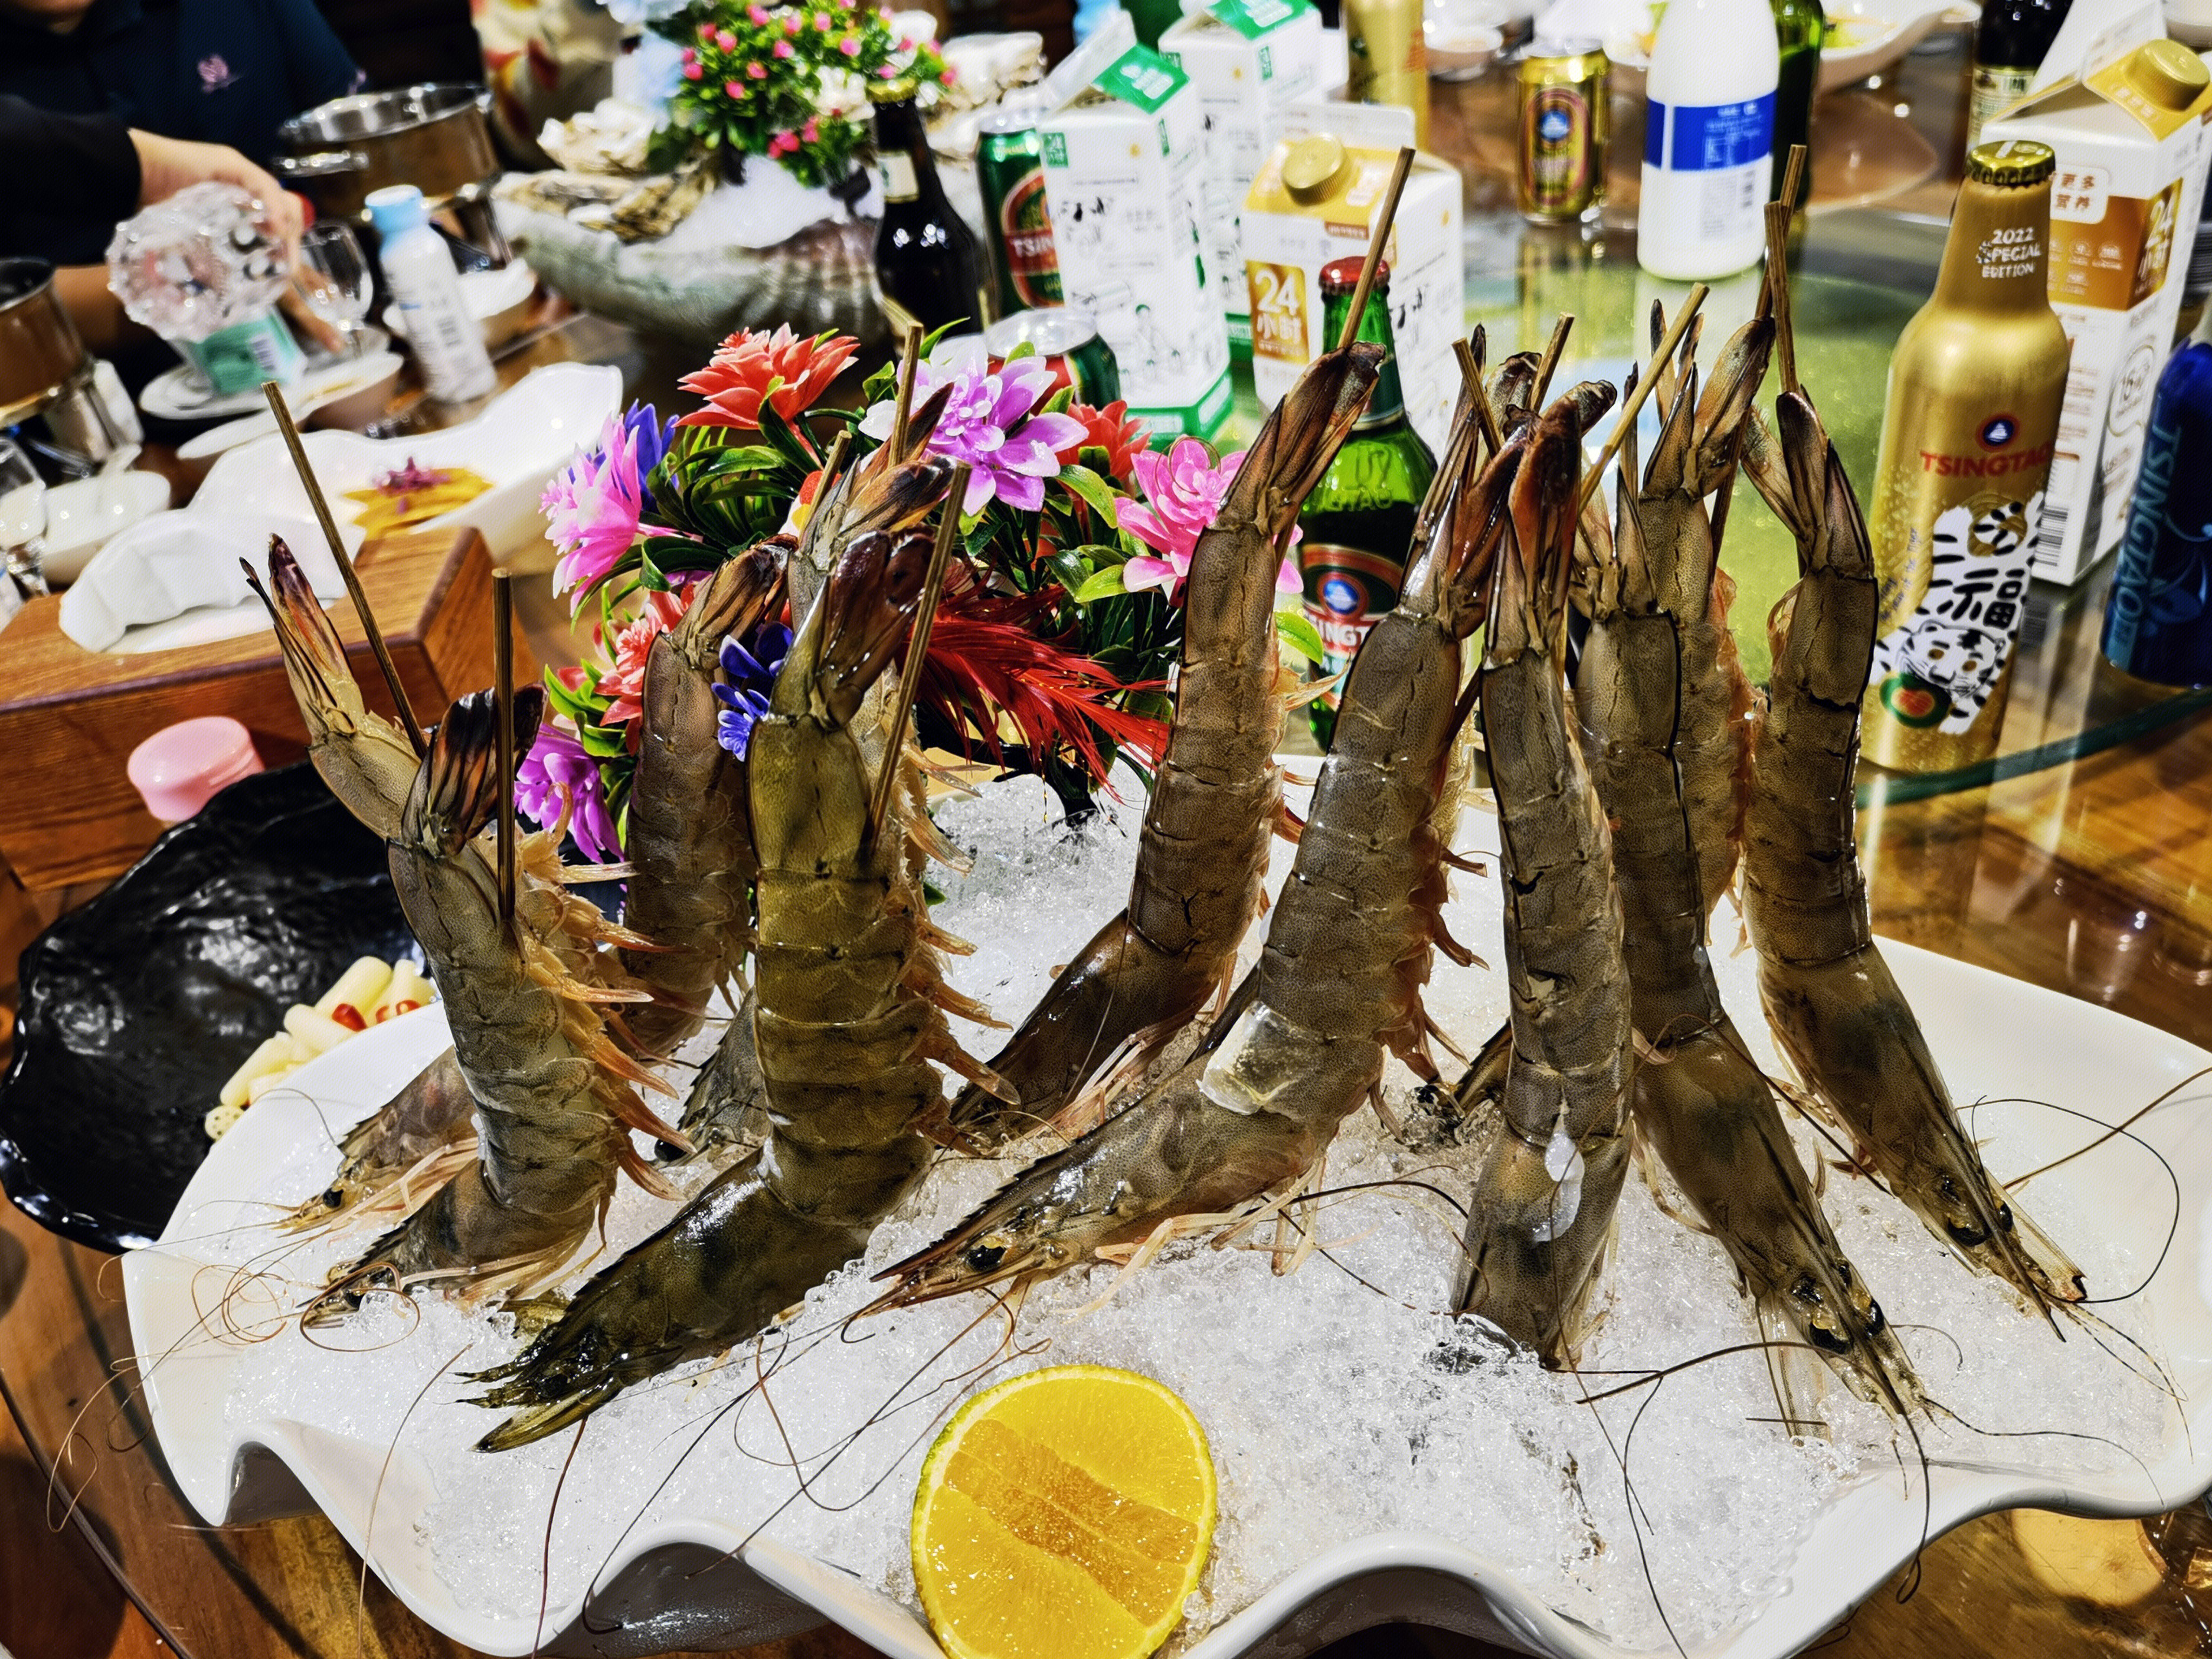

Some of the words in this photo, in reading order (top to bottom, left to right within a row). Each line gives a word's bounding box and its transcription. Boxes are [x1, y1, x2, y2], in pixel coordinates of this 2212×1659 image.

[1009, 238, 1052, 258] TSIN
[1991, 227, 2034, 244] 2022
[1975, 241, 2041, 264] SPECIAL
[1982, 262, 2034, 278] EDITION
[1255, 268, 1299, 316] 24
[1257, 313, 1301, 344] 小时
[1919, 445, 2053, 477] TSINGTAO
[2115, 426, 2182, 623] TSINGTAO
[1936, 568, 2025, 631] 福
[1306, 613, 1372, 646] INGT
